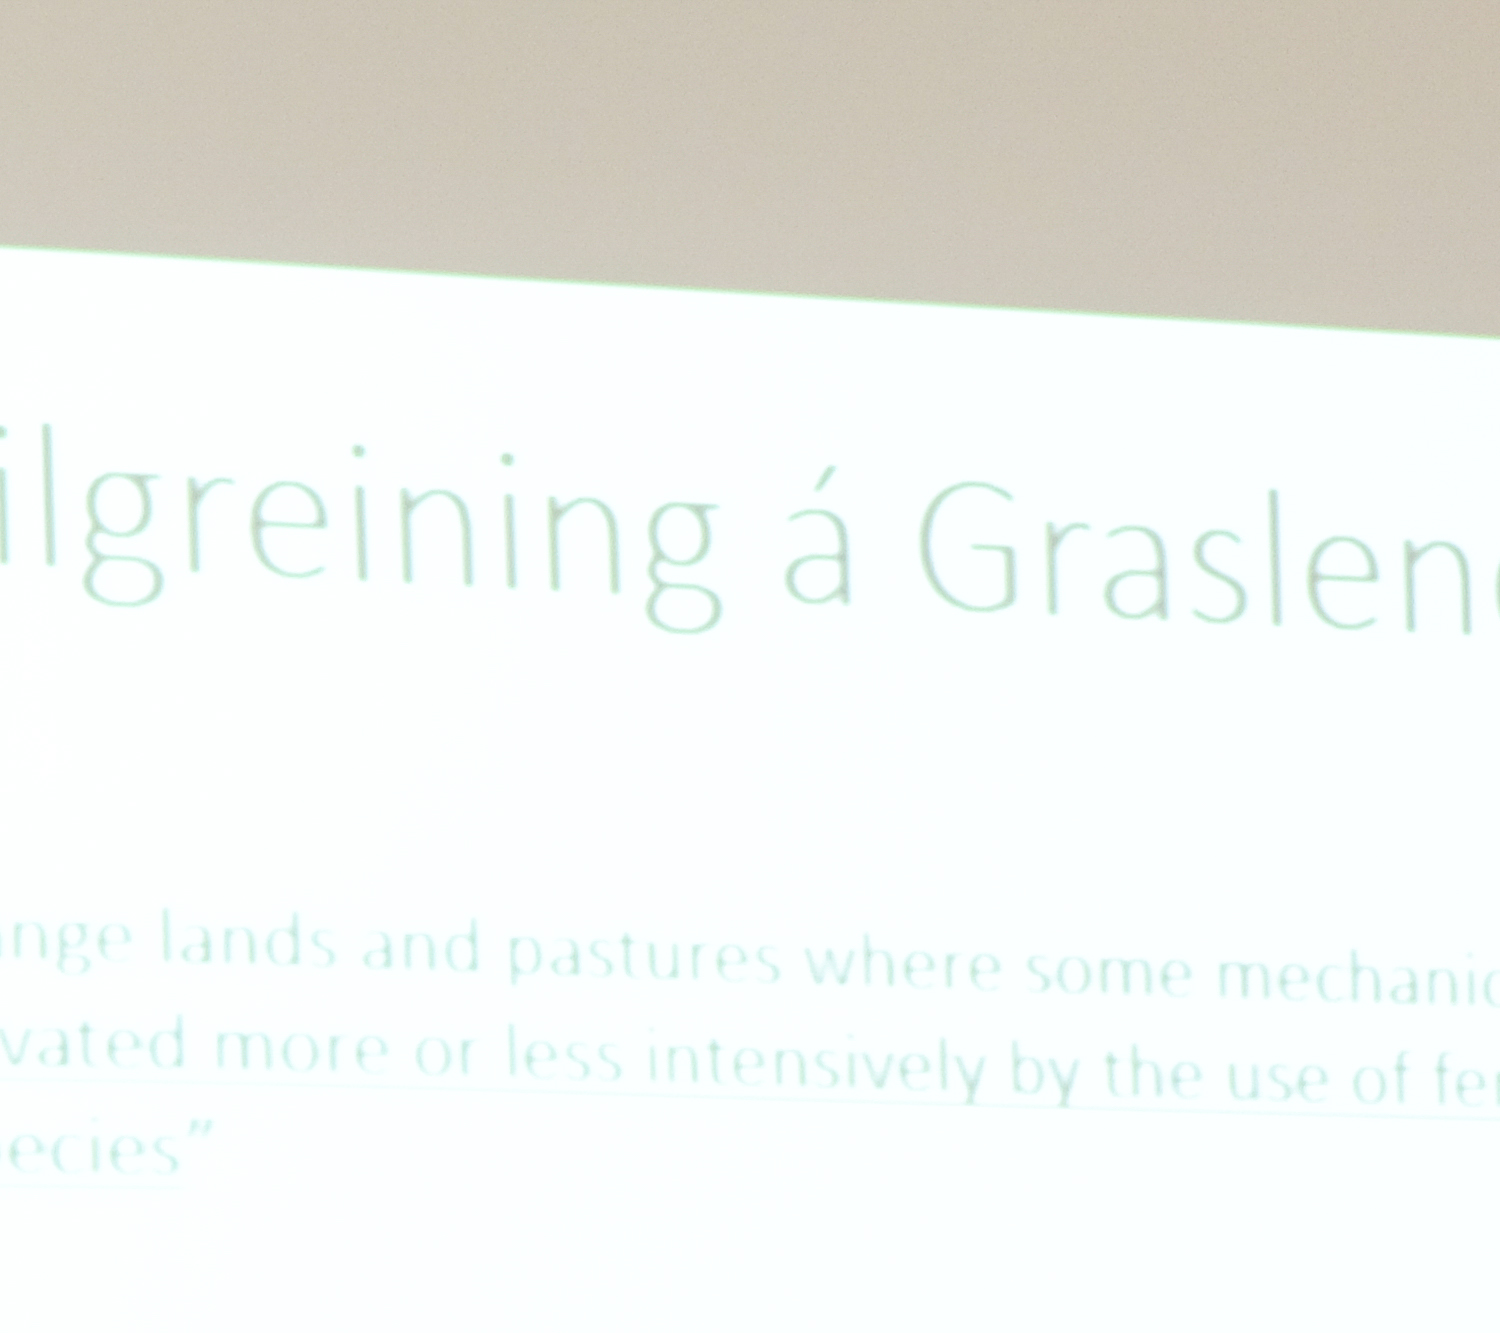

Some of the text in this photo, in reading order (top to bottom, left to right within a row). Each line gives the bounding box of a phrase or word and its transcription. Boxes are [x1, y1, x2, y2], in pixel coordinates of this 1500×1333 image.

[783, 463, 853, 607] á
[159, 906, 339, 969] lands
[360, 916, 482, 975] and
[506, 930, 784, 988] pastures
[802, 931, 1004, 991] where
[1024, 954, 1195, 997] some
[214, 1030, 391, 1074] more
[413, 1036, 476, 1077] or
[505, 1021, 625, 1083] less
[647, 1036, 988, 1109] intensively
[1009, 1039, 1082, 1111] by
[1102, 1042, 1205, 1099] the
[1225, 1061, 1331, 1103] use
[1350, 1049, 1411, 1105] of
